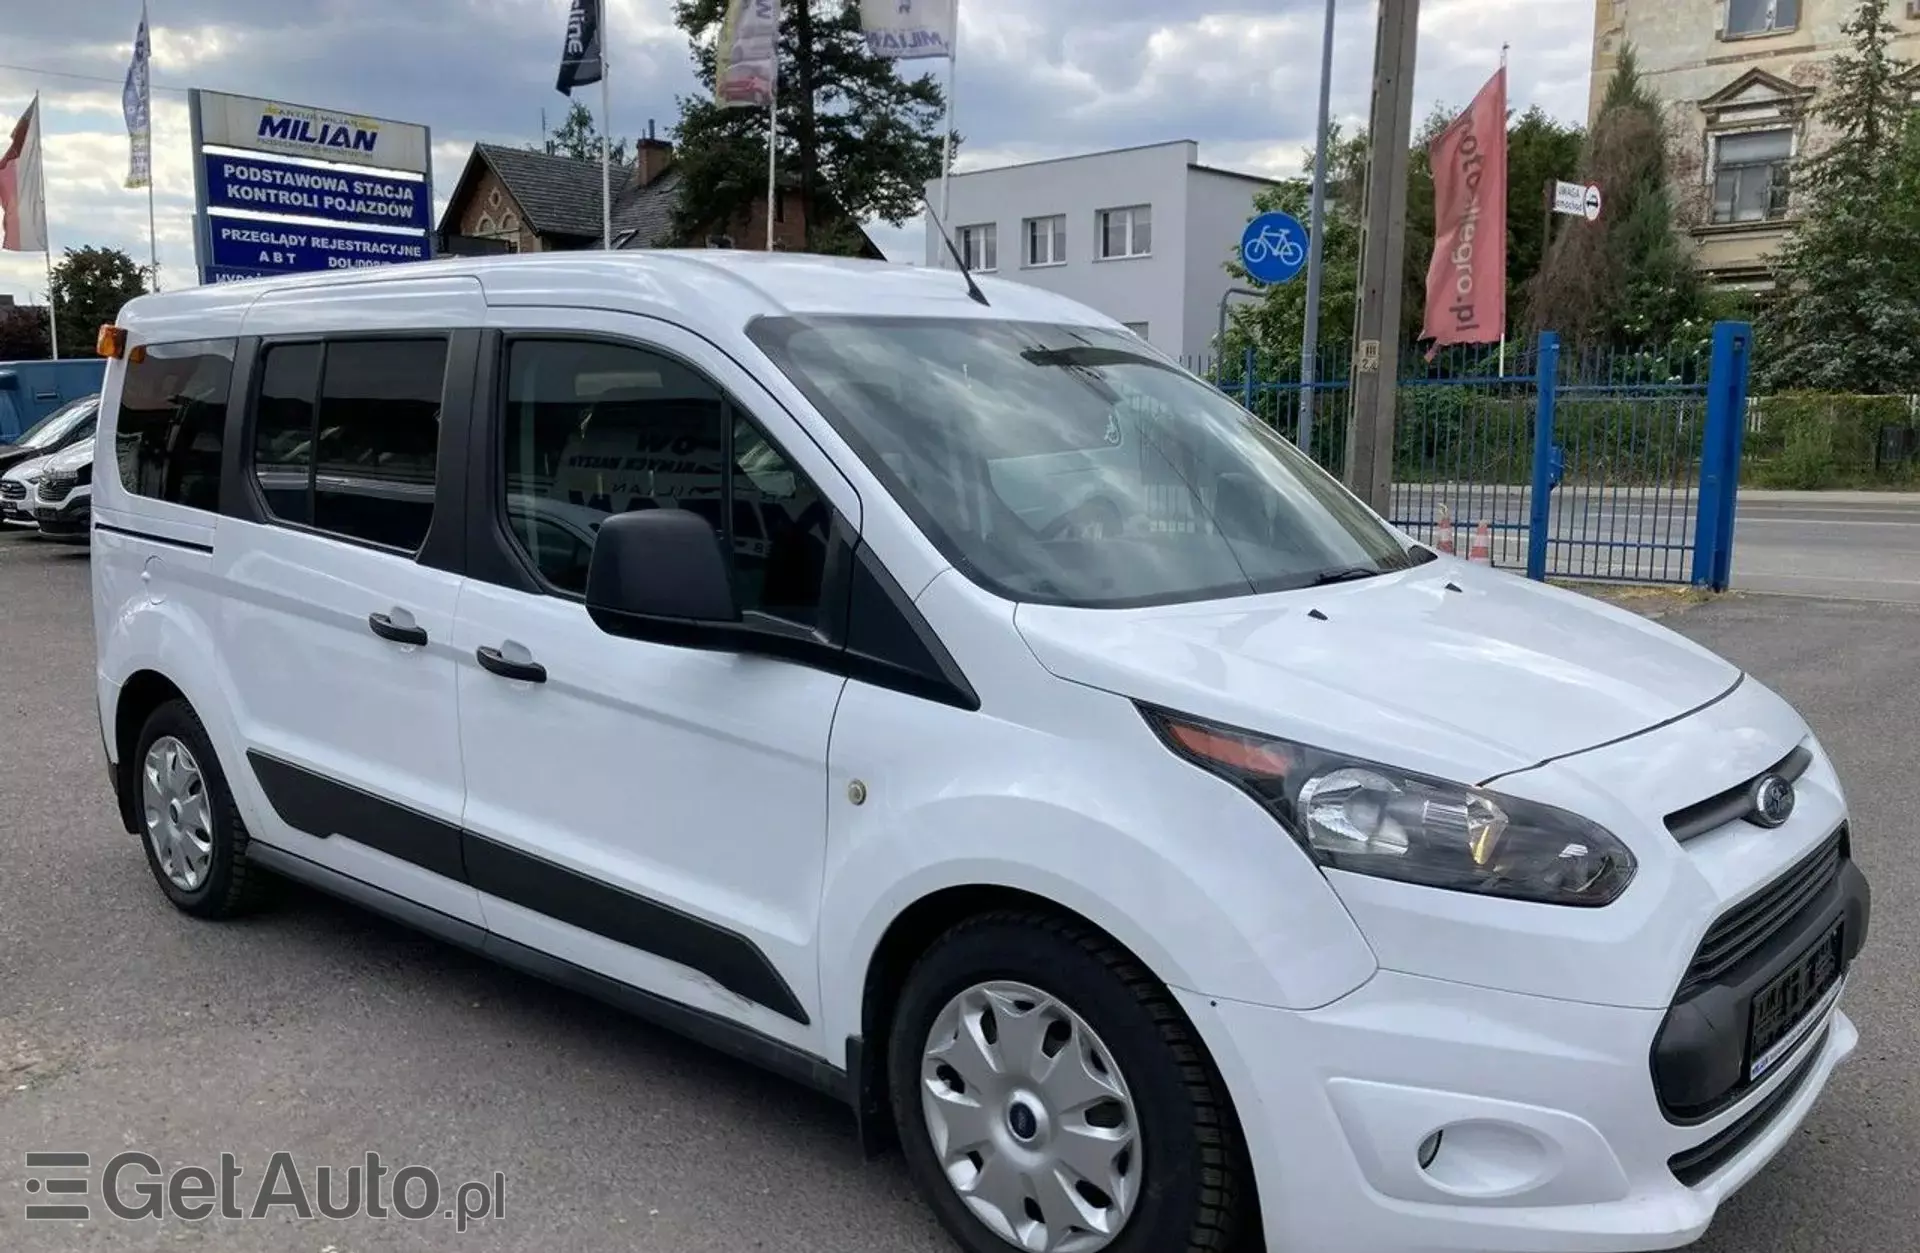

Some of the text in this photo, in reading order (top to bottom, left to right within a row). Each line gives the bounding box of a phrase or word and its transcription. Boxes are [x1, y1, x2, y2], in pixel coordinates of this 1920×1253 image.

[258, 115, 378, 152] MILIAN
[224, 164, 414, 200] PODSTAWOWA STACJA
[227, 184, 413, 218] KONTROLI POJAZDÓW
[221, 228, 422, 257] PRZEGLĄDY REJESTRACYJNE
